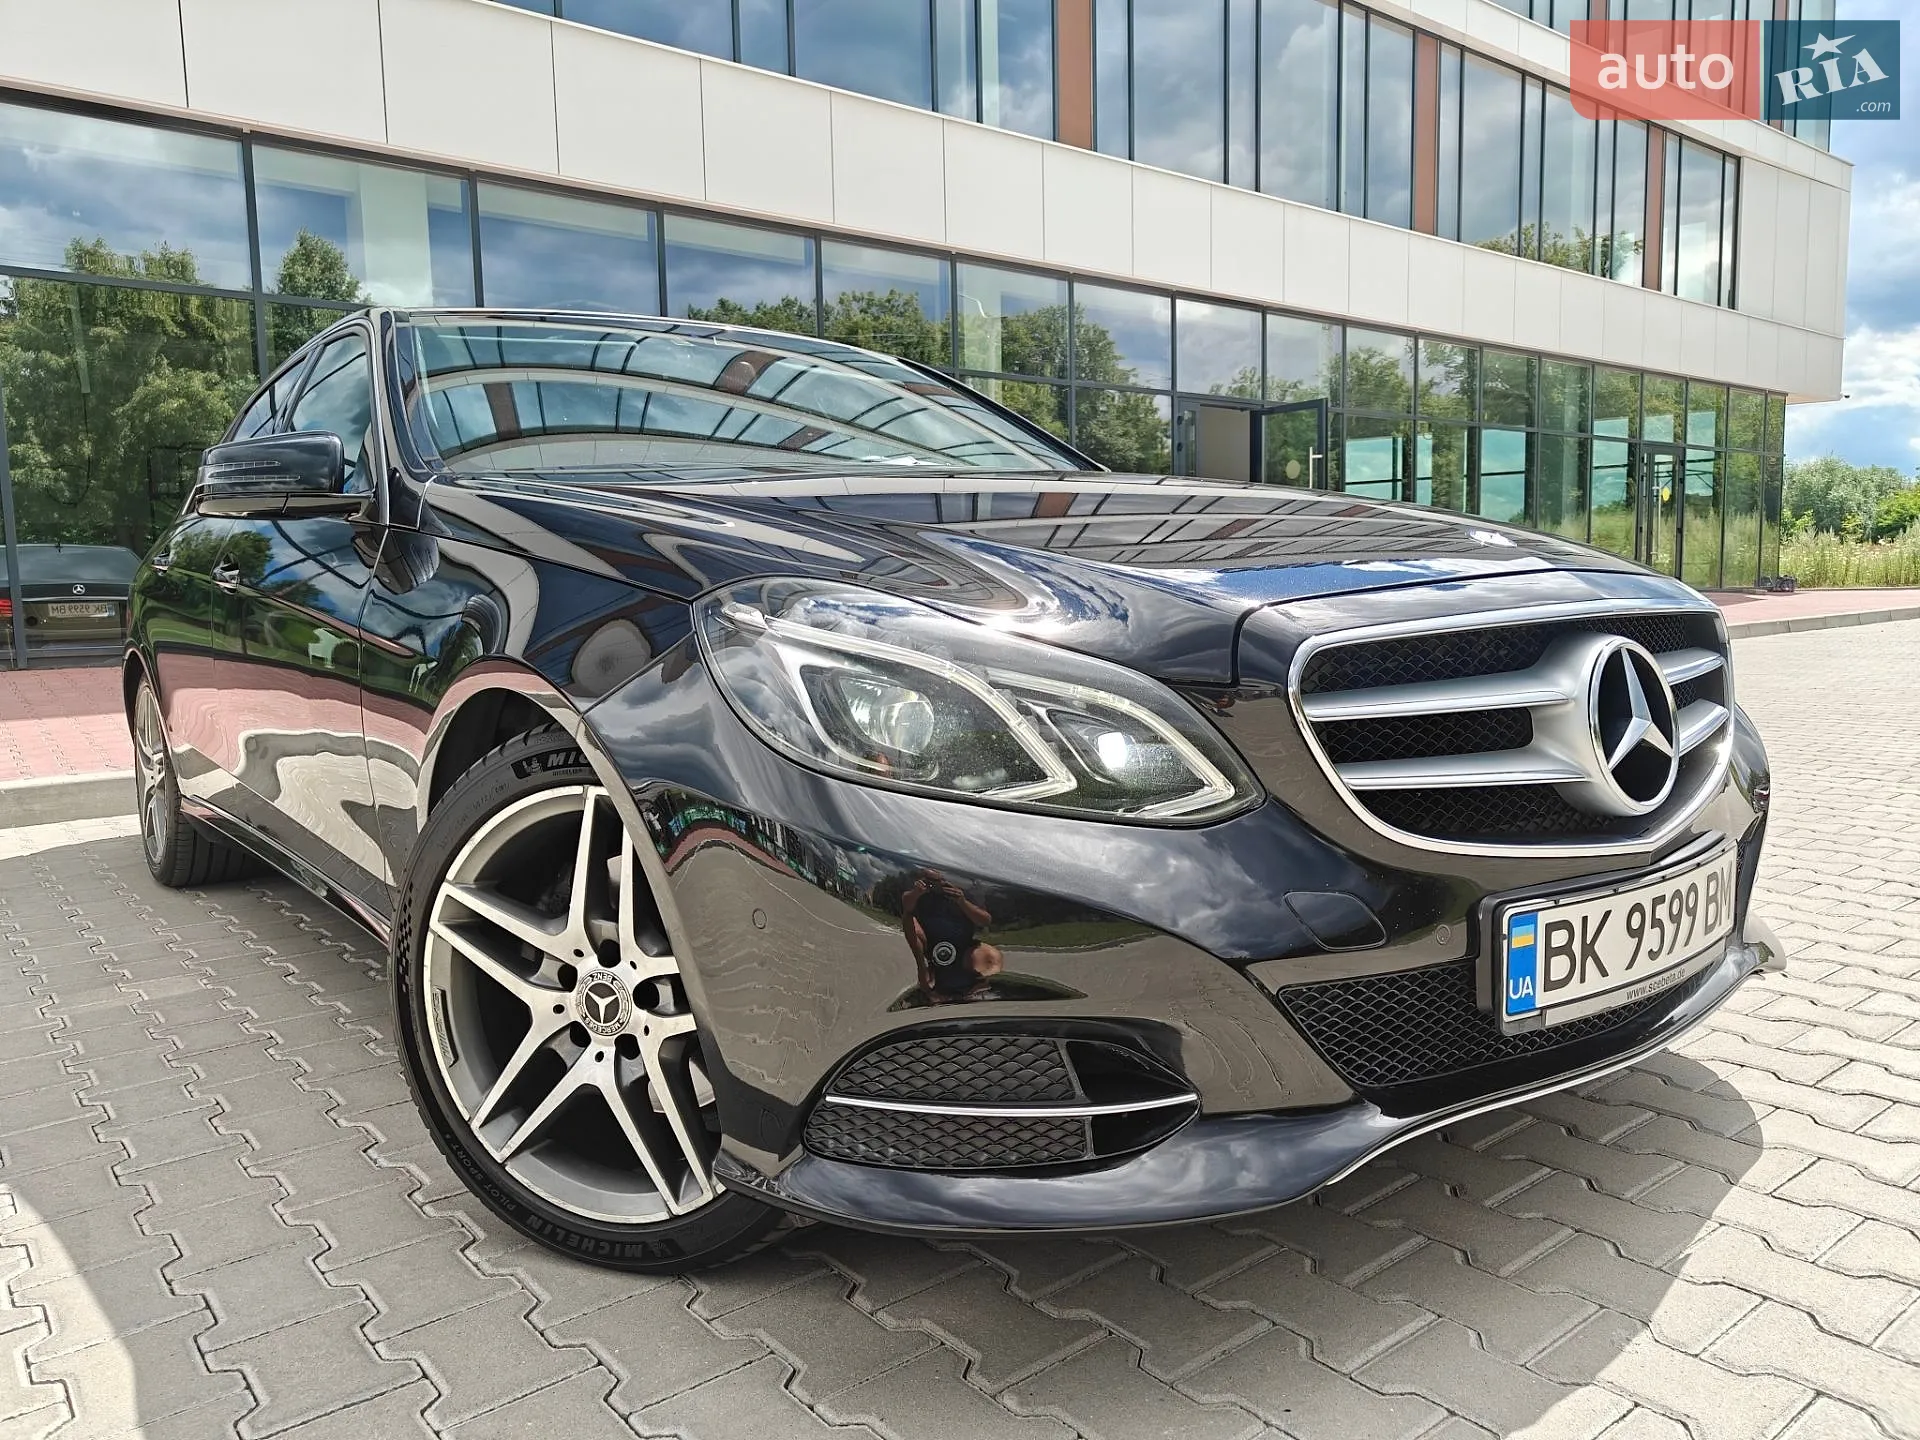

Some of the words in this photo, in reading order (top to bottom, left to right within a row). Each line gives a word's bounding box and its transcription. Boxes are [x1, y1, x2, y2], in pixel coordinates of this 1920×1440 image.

[1543, 909, 1613, 993] BK
[1624, 882, 1699, 971] 9599
[1704, 860, 1733, 936] BM
[592, 972, 613, 983] BENZ
[1509, 976, 1534, 999] UA
[585, 1017, 621, 1034] MERCEDES
[450, 1143, 484, 1182] SPORT
[482, 1182, 518, 1211] PILOT
[525, 1213, 643, 1259] MICHELIN
